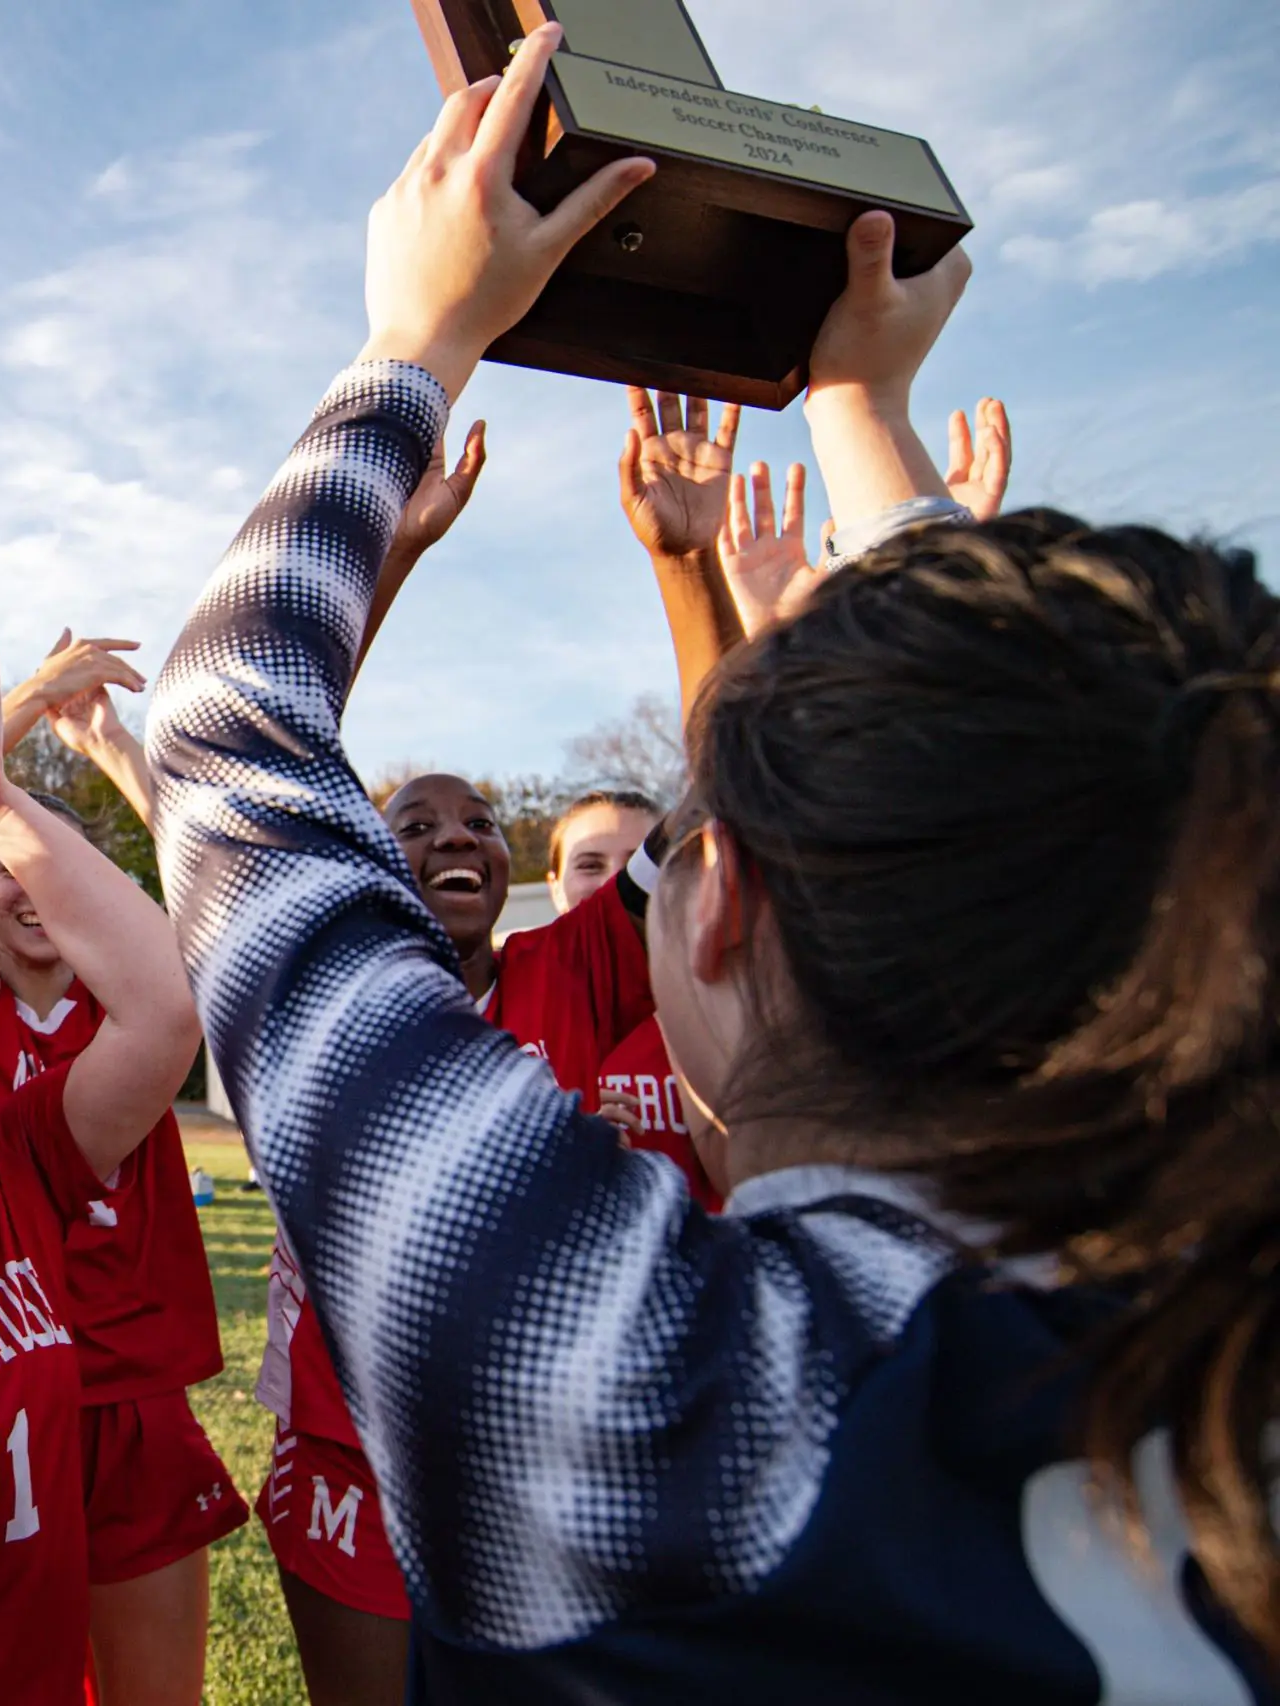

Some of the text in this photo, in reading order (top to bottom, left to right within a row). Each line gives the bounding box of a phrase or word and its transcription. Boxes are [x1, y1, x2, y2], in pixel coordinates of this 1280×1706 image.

[604, 70, 723, 111] Independent
[781, 112, 881, 148] Conference
[672, 105, 842, 159] Soccer Champions
[743, 142, 794, 167] 2024
[306, 1474, 364, 1559] M
